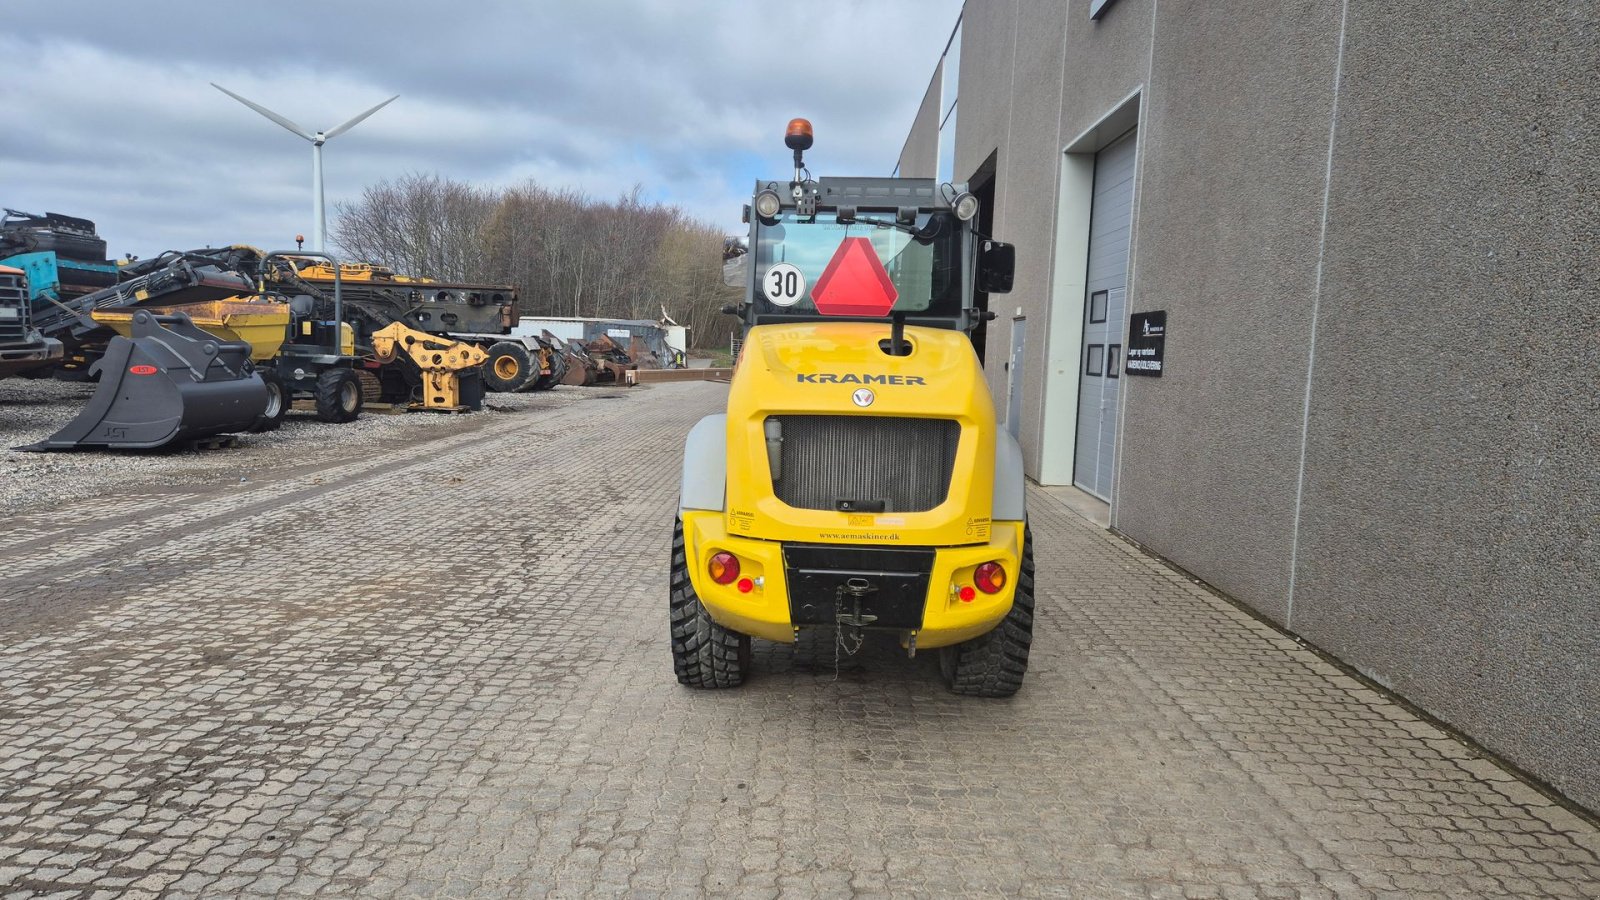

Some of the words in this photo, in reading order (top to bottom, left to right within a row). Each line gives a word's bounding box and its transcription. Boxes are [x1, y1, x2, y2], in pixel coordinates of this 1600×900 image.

[770, 270, 798, 298] 30
[796, 373, 928, 386] KRAMER
[819, 533, 901, 541] www.aemaskiner.dk
